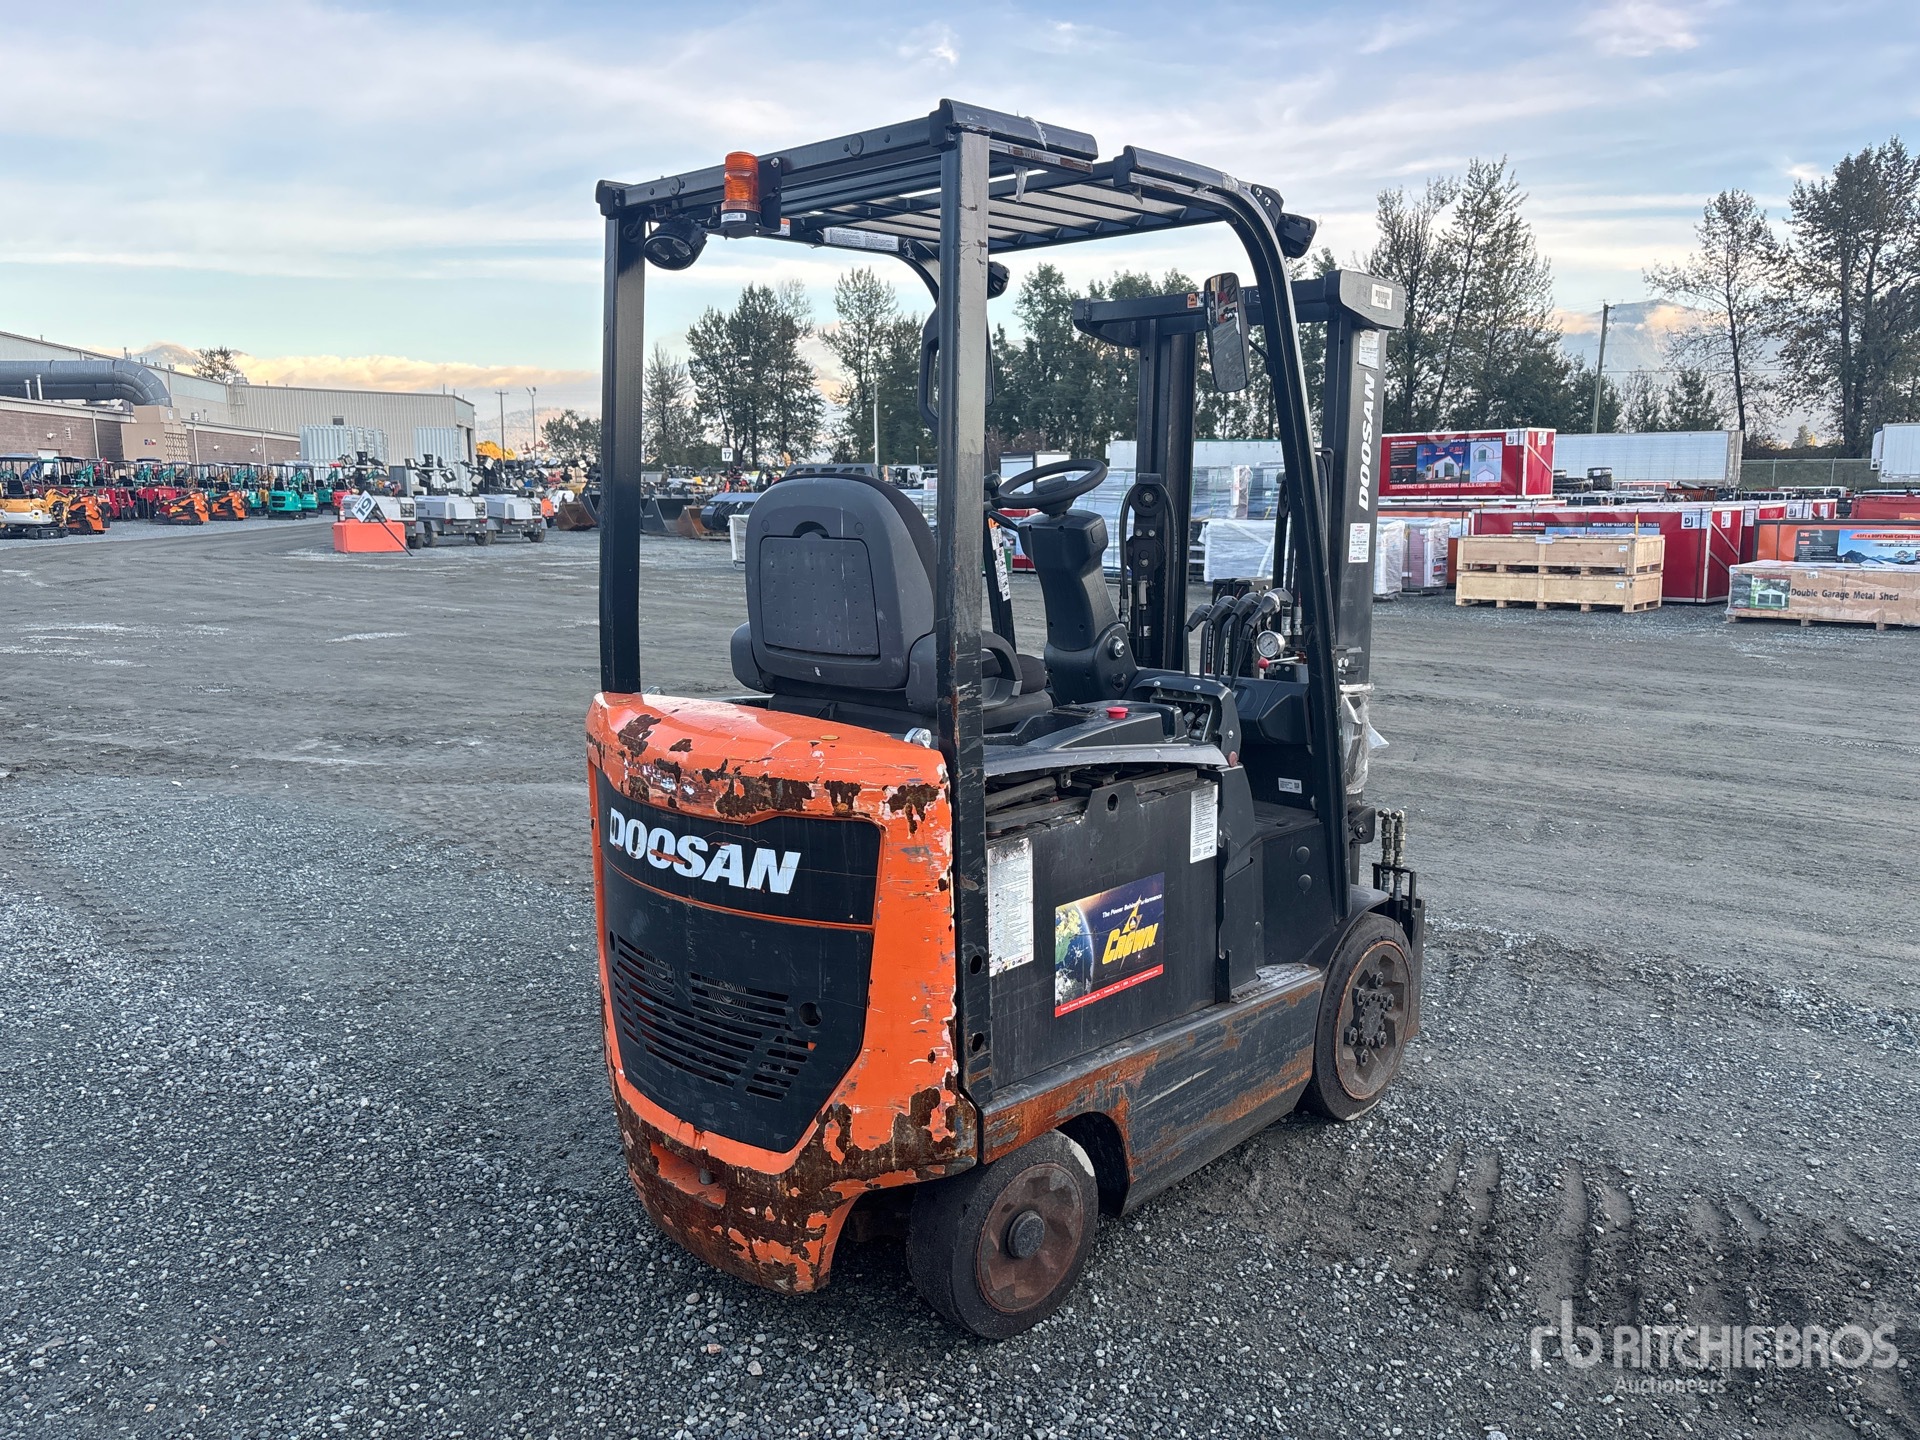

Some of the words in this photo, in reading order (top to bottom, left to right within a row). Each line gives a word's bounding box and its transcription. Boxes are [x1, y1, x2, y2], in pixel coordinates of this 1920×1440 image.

[1358, 372, 1375, 511] DOOSAN
[723, 451, 731, 460] 17
[356, 497, 372, 516] 19
[1791, 587, 1818, 598] Double
[1821, 589, 1850, 600] Garage
[1852, 590, 1876, 601] Metal
[1879, 590, 1900, 602] Shed
[609, 807, 802, 895] DOOSAN
[1102, 911, 1110, 919] The
[1110, 907, 1124, 915] Power
